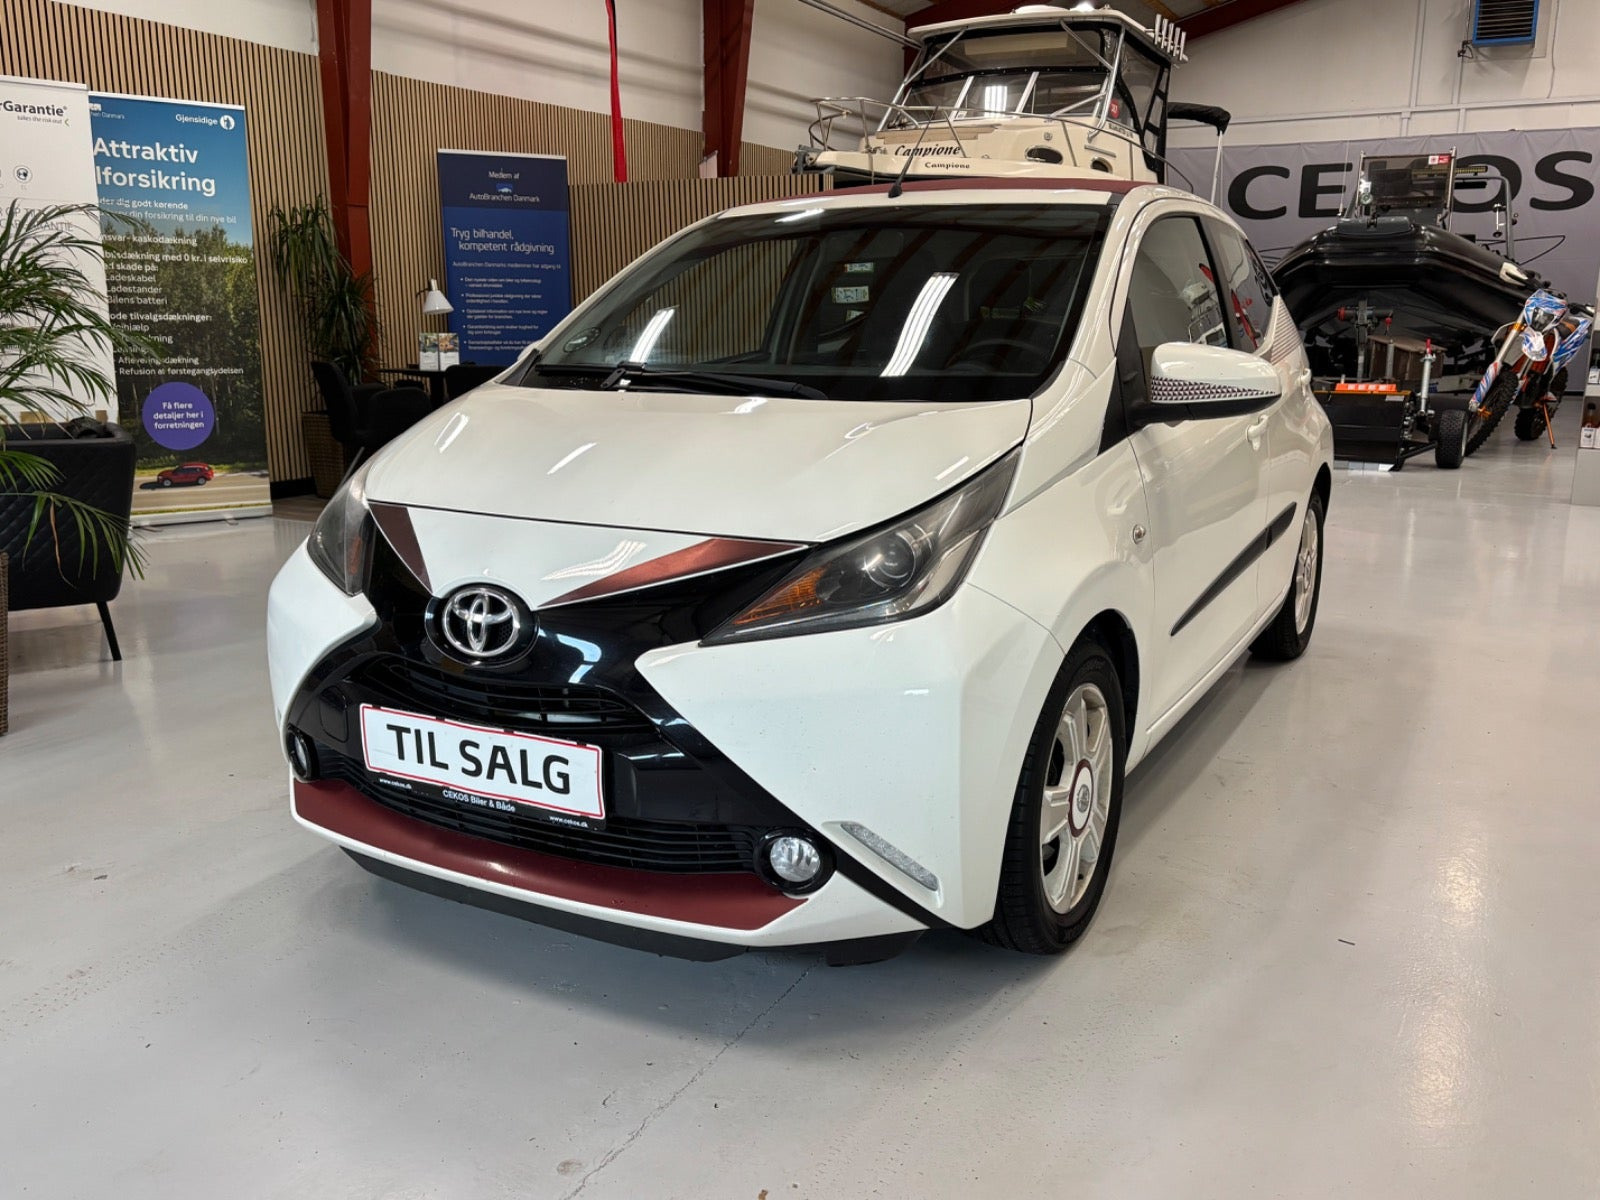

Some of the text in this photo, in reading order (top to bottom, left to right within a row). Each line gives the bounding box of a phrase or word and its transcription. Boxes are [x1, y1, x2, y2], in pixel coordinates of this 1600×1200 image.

[175, 113, 218, 127] Gjensidige
[94, 137, 198, 164] Attraktiv
[894, 143, 961, 158] Campione
[488, 171, 513, 180] Medlem
[1227, 150, 1596, 220] CEOS
[469, 192, 540, 203] AutoBranchen Danmark
[131, 199, 152, 209] godt
[153, 201, 189, 210] kørende
[144, 211, 184, 223] forsikring
[186, 213, 194, 222] til
[195, 214, 209, 223] din
[210, 216, 225, 225] nye
[226, 215, 237, 224] bil
[450, 227, 514, 240] Tryg bilhandel,
[132, 235, 198, 247] kaskodækning
[458, 241, 555, 255] kompetent rådgivning
[162, 253, 182, 263] med
[183, 254, 189, 262] 0
[208, 256, 248, 265] selvrisiko
[116, 263, 143, 272] skade
[137, 296, 168, 305] batteri
[119, 367, 156, 376] Refusion
[162, 401, 193, 410] Få flere
[153, 411, 184, 421] detaljer
[186, 411, 199, 419] her
[154, 421, 205, 430] forretningen
[386, 723, 570, 796] TIL SALG
[442, 789, 469, 803] CEKOS
[470, 795, 487, 807] Biler
[495, 801, 516, 813] Både
